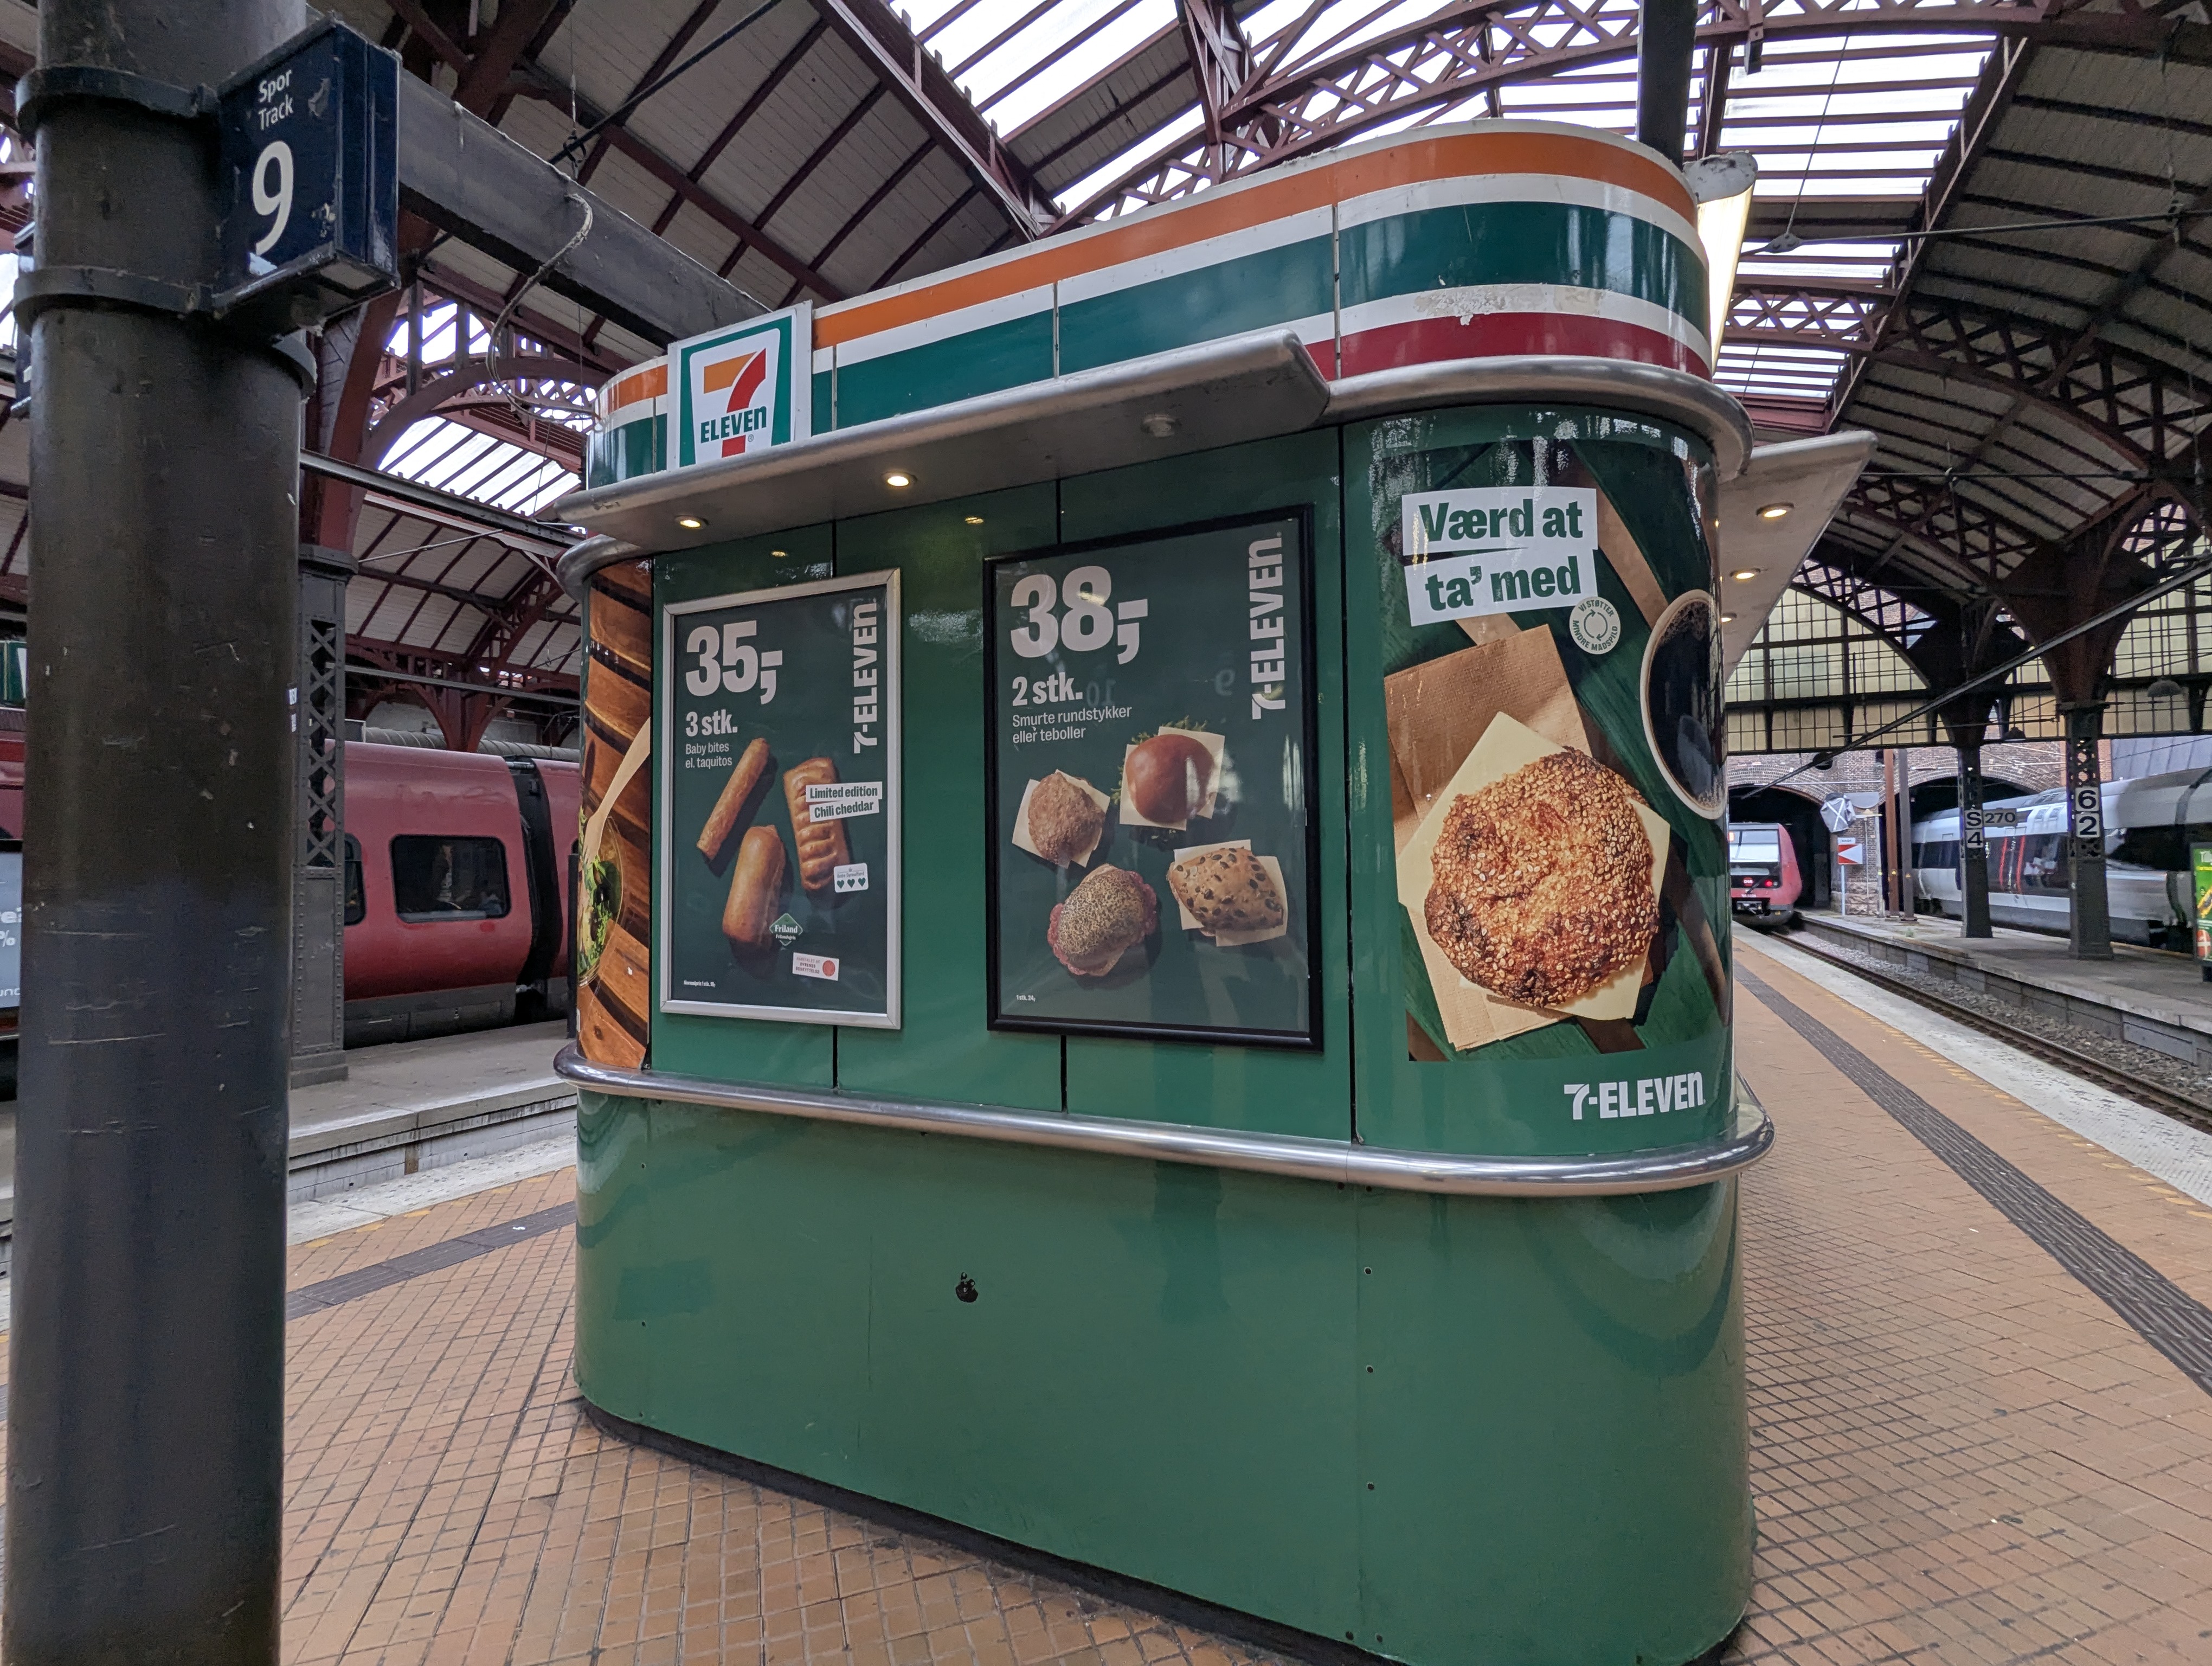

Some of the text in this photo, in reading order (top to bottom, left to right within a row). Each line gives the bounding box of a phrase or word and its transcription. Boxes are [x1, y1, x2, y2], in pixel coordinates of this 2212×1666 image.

[259, 69, 292, 102] Spor
[259, 94, 293, 130] Track
[252, 140, 294, 255] 9
[704, 348, 766, 457] 7
[1419, 498, 1584, 542] Værd at
[1491, 556, 1581, 602] med
[1578, 599, 1614, 617] VI STØTTER
[1573, 620, 1618, 651] MINDRE MADSPILD
[1012, 671, 1083, 706] 2 stk.
[686, 709, 738, 737] 3 stk.
[1012, 705, 1133, 727] Smurte rundstykker
[1012, 726, 1086, 744] eller teboller
[685, 742, 730, 756] Baby bites
[685, 756, 732, 770] el. taquitos
[810, 786, 878, 799] Limited edition
[2078, 790, 2097, 809] 6
[814, 800, 874, 818] Chili cheddar
[1966, 811, 1982, 826] S
[1984, 812, 2016, 824] 270
[2079, 816, 2098, 836] 2
[1967, 831, 1983, 846] 4
[775, 925, 798, 933] Friland
